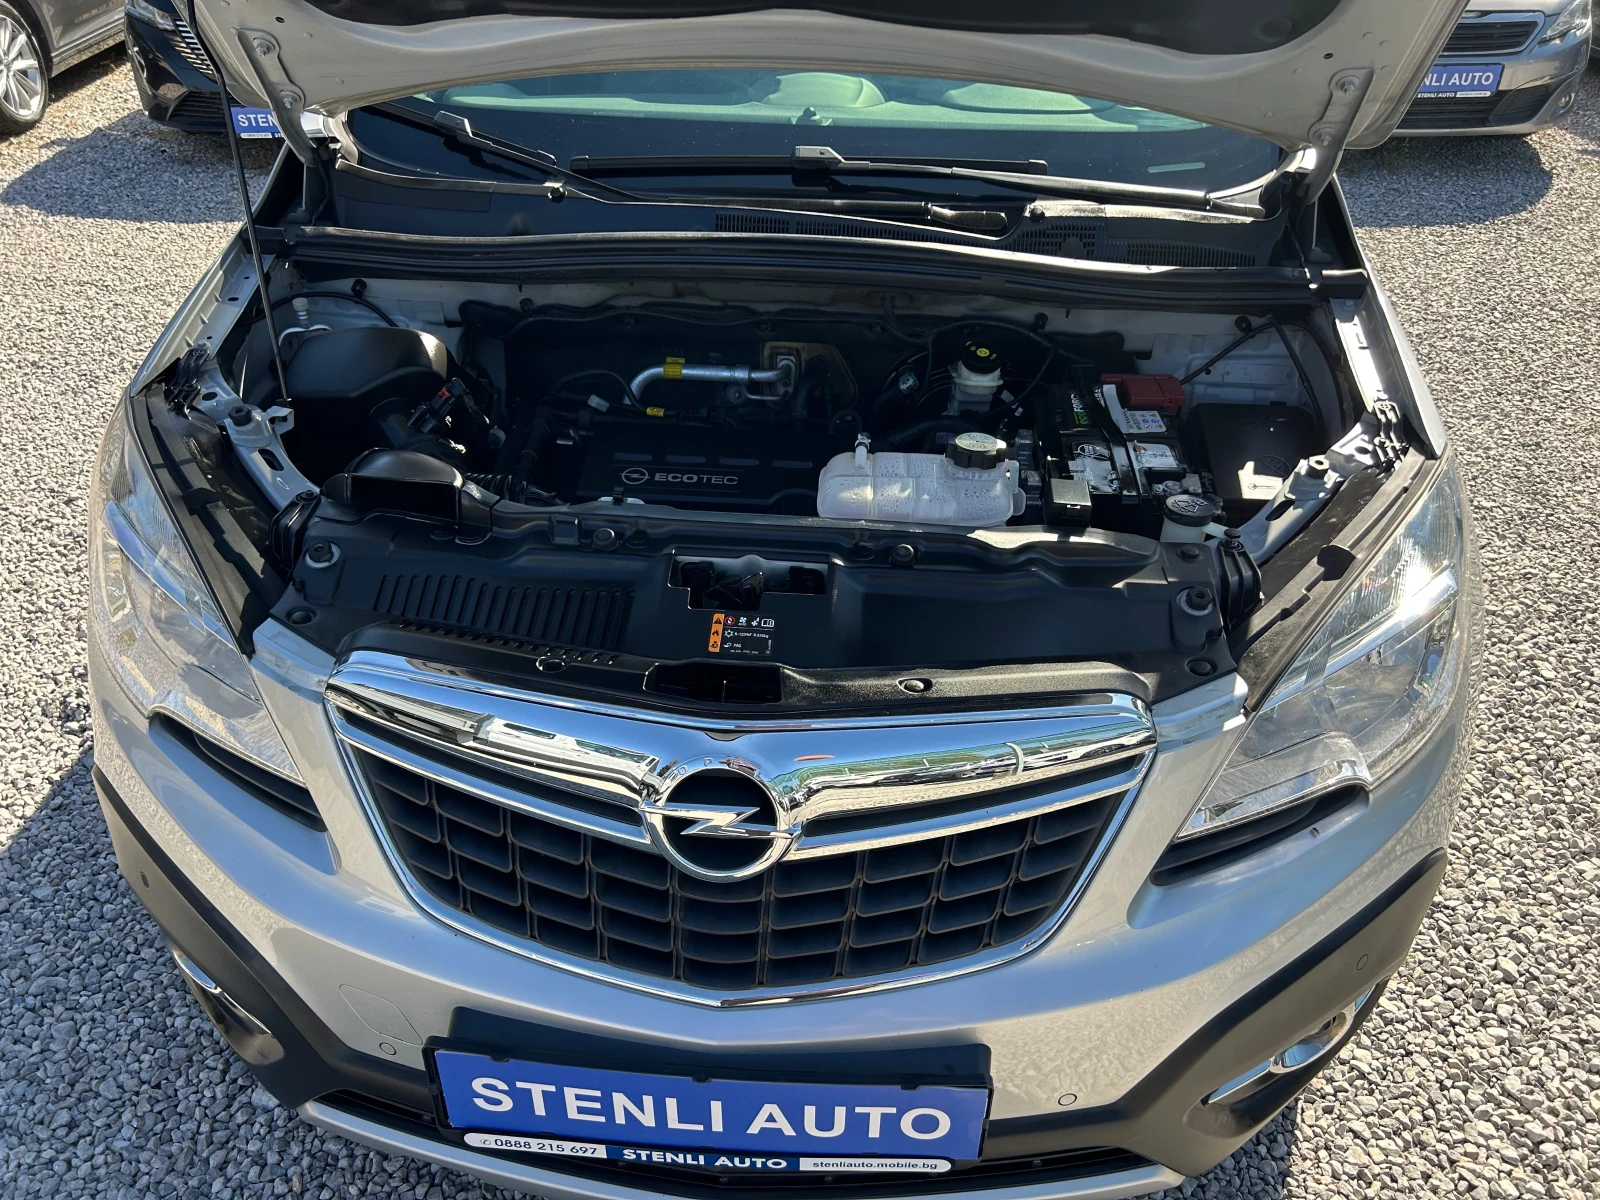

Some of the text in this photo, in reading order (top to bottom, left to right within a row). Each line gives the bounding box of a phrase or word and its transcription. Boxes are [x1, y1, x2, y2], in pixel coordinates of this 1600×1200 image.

[1423, 72, 1494, 86] NLI AUTO
[237, 114, 274, 127] STEN
[654, 472, 739, 485] ECOTEC
[471, 1077, 951, 1140] STENLI AUTO
[494, 1138, 598, 1156] 0888 215 697
[623, 1148, 788, 1169] STENLI AUTO
[812, 1161, 938, 1170] stenliauto.mobile.bg
